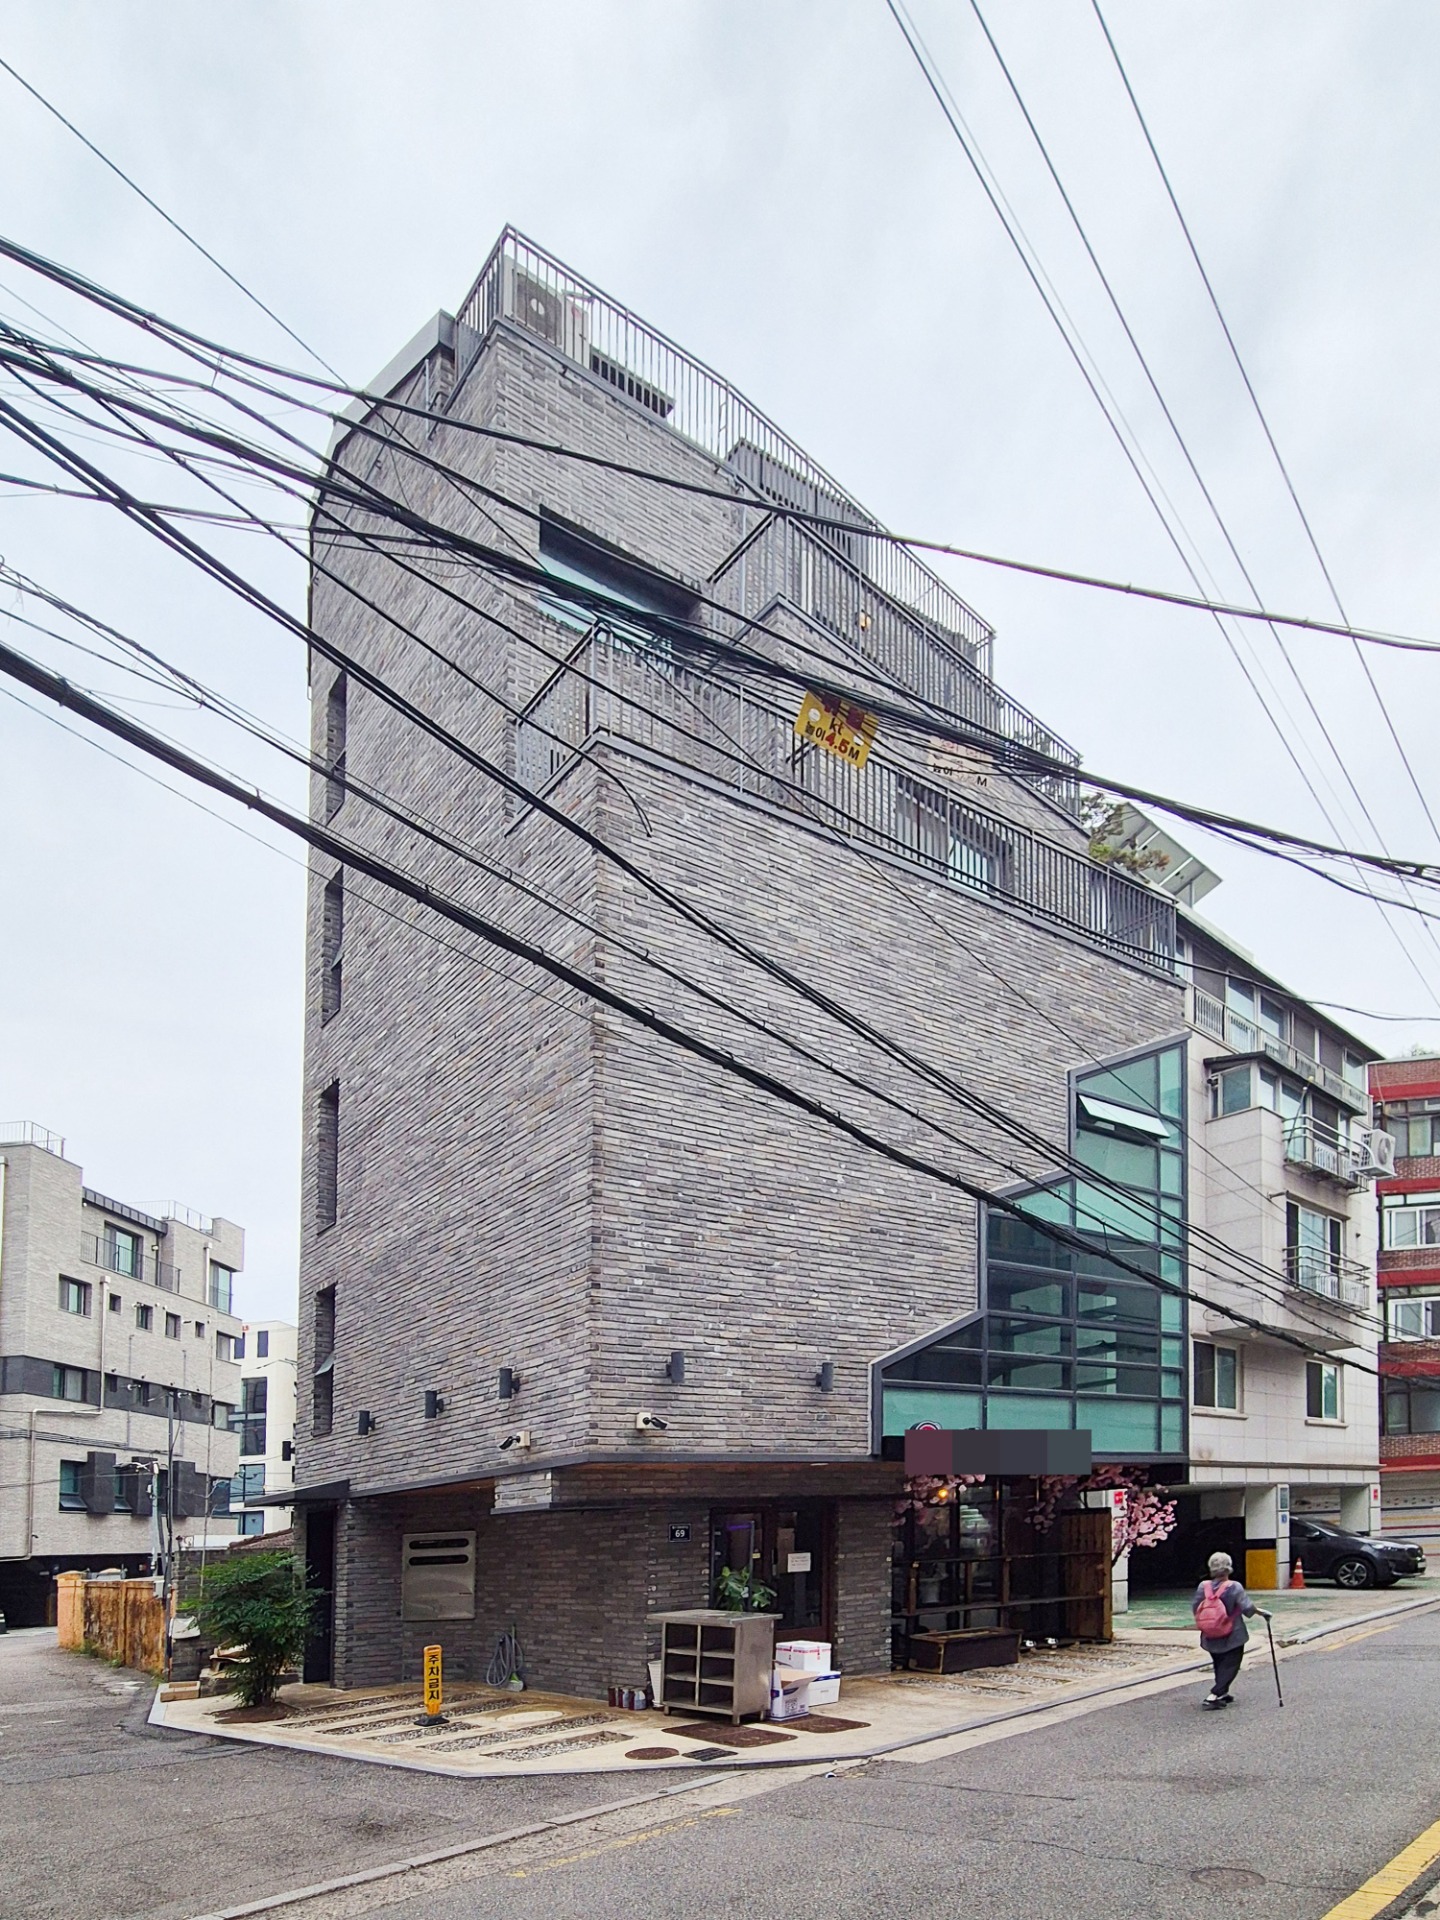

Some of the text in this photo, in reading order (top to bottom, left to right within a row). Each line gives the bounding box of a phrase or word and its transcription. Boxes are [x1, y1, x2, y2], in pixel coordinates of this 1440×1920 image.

[829, 717, 843, 735] kt
[675, 1529, 685, 1538] 69
[428, 1654, 440, 1701] 주차금지
